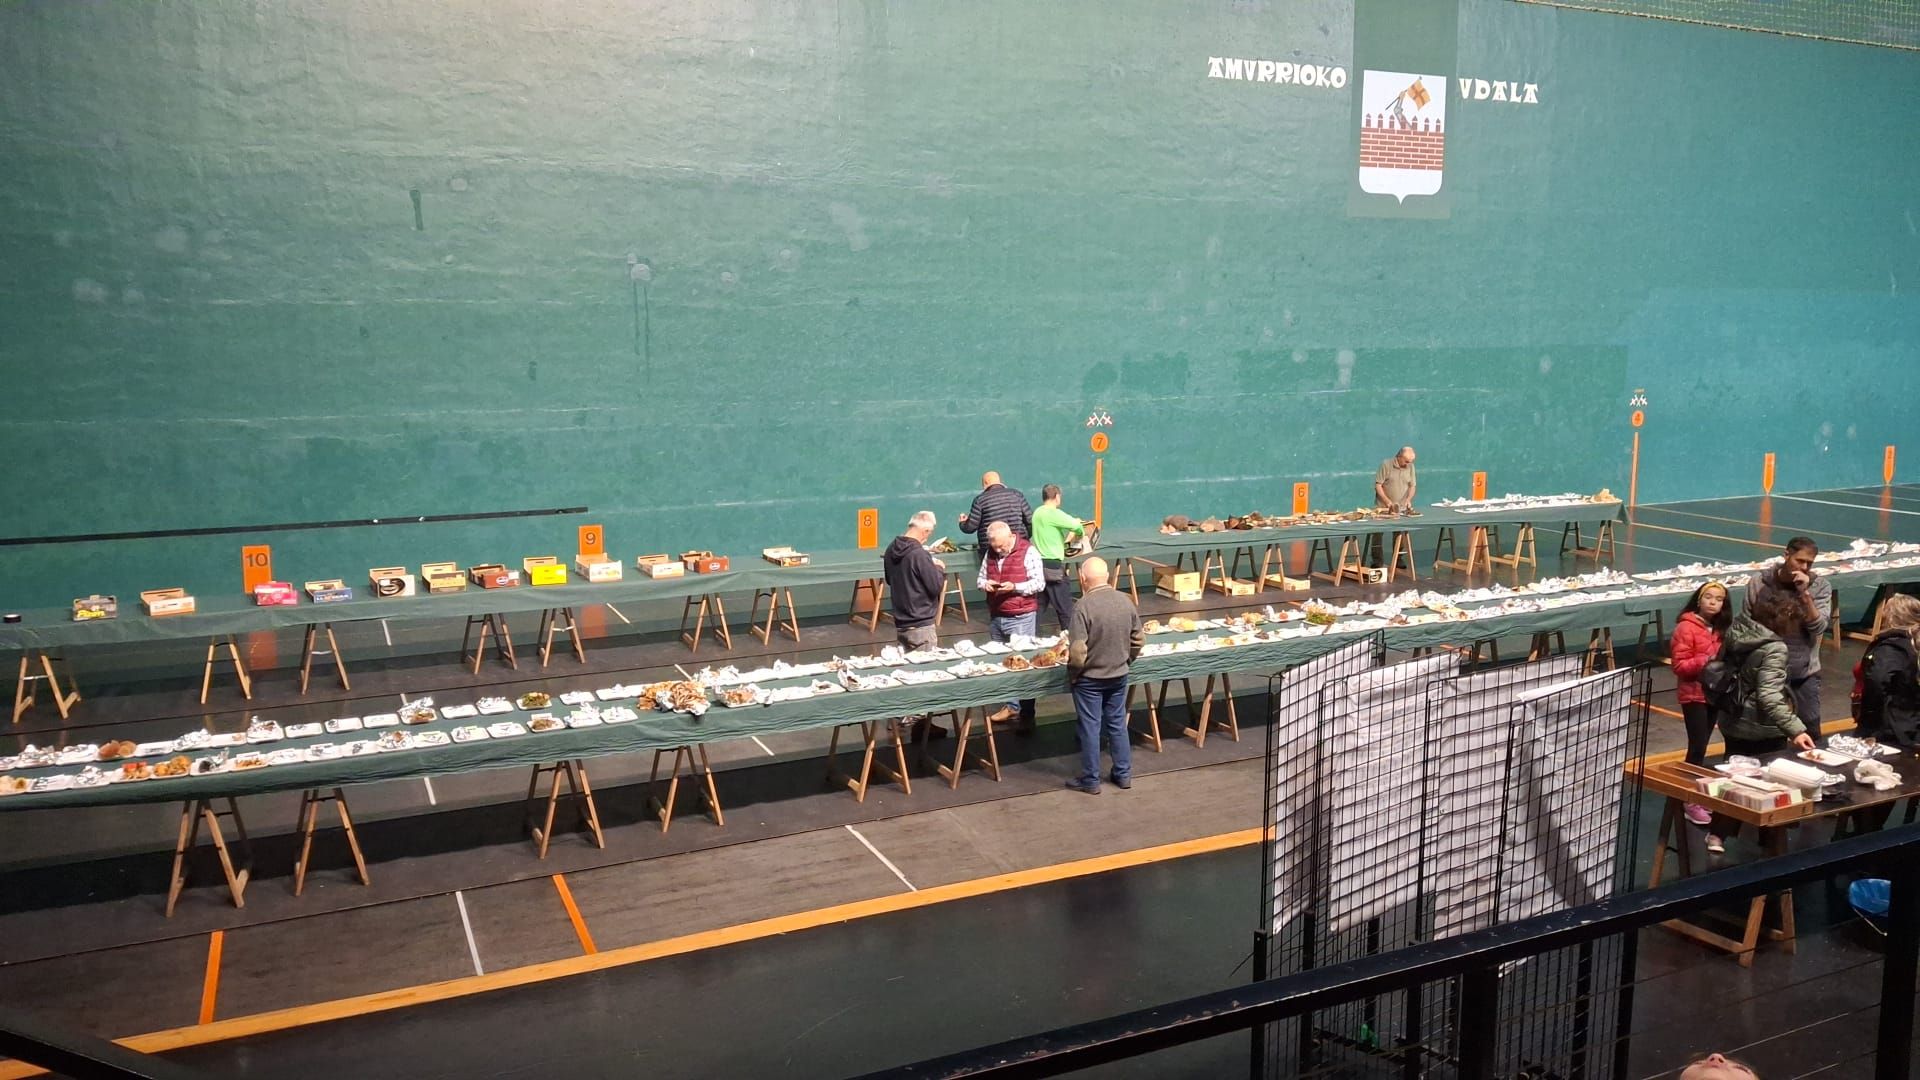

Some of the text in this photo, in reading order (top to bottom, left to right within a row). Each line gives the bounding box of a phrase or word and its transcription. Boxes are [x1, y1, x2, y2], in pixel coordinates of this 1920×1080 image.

[1095, 437, 1104, 449] 7
[1298, 487, 1305, 498] 6
[863, 514, 872, 527] 8
[585, 532, 596, 545] 9
[245, 552, 268, 568] 10
